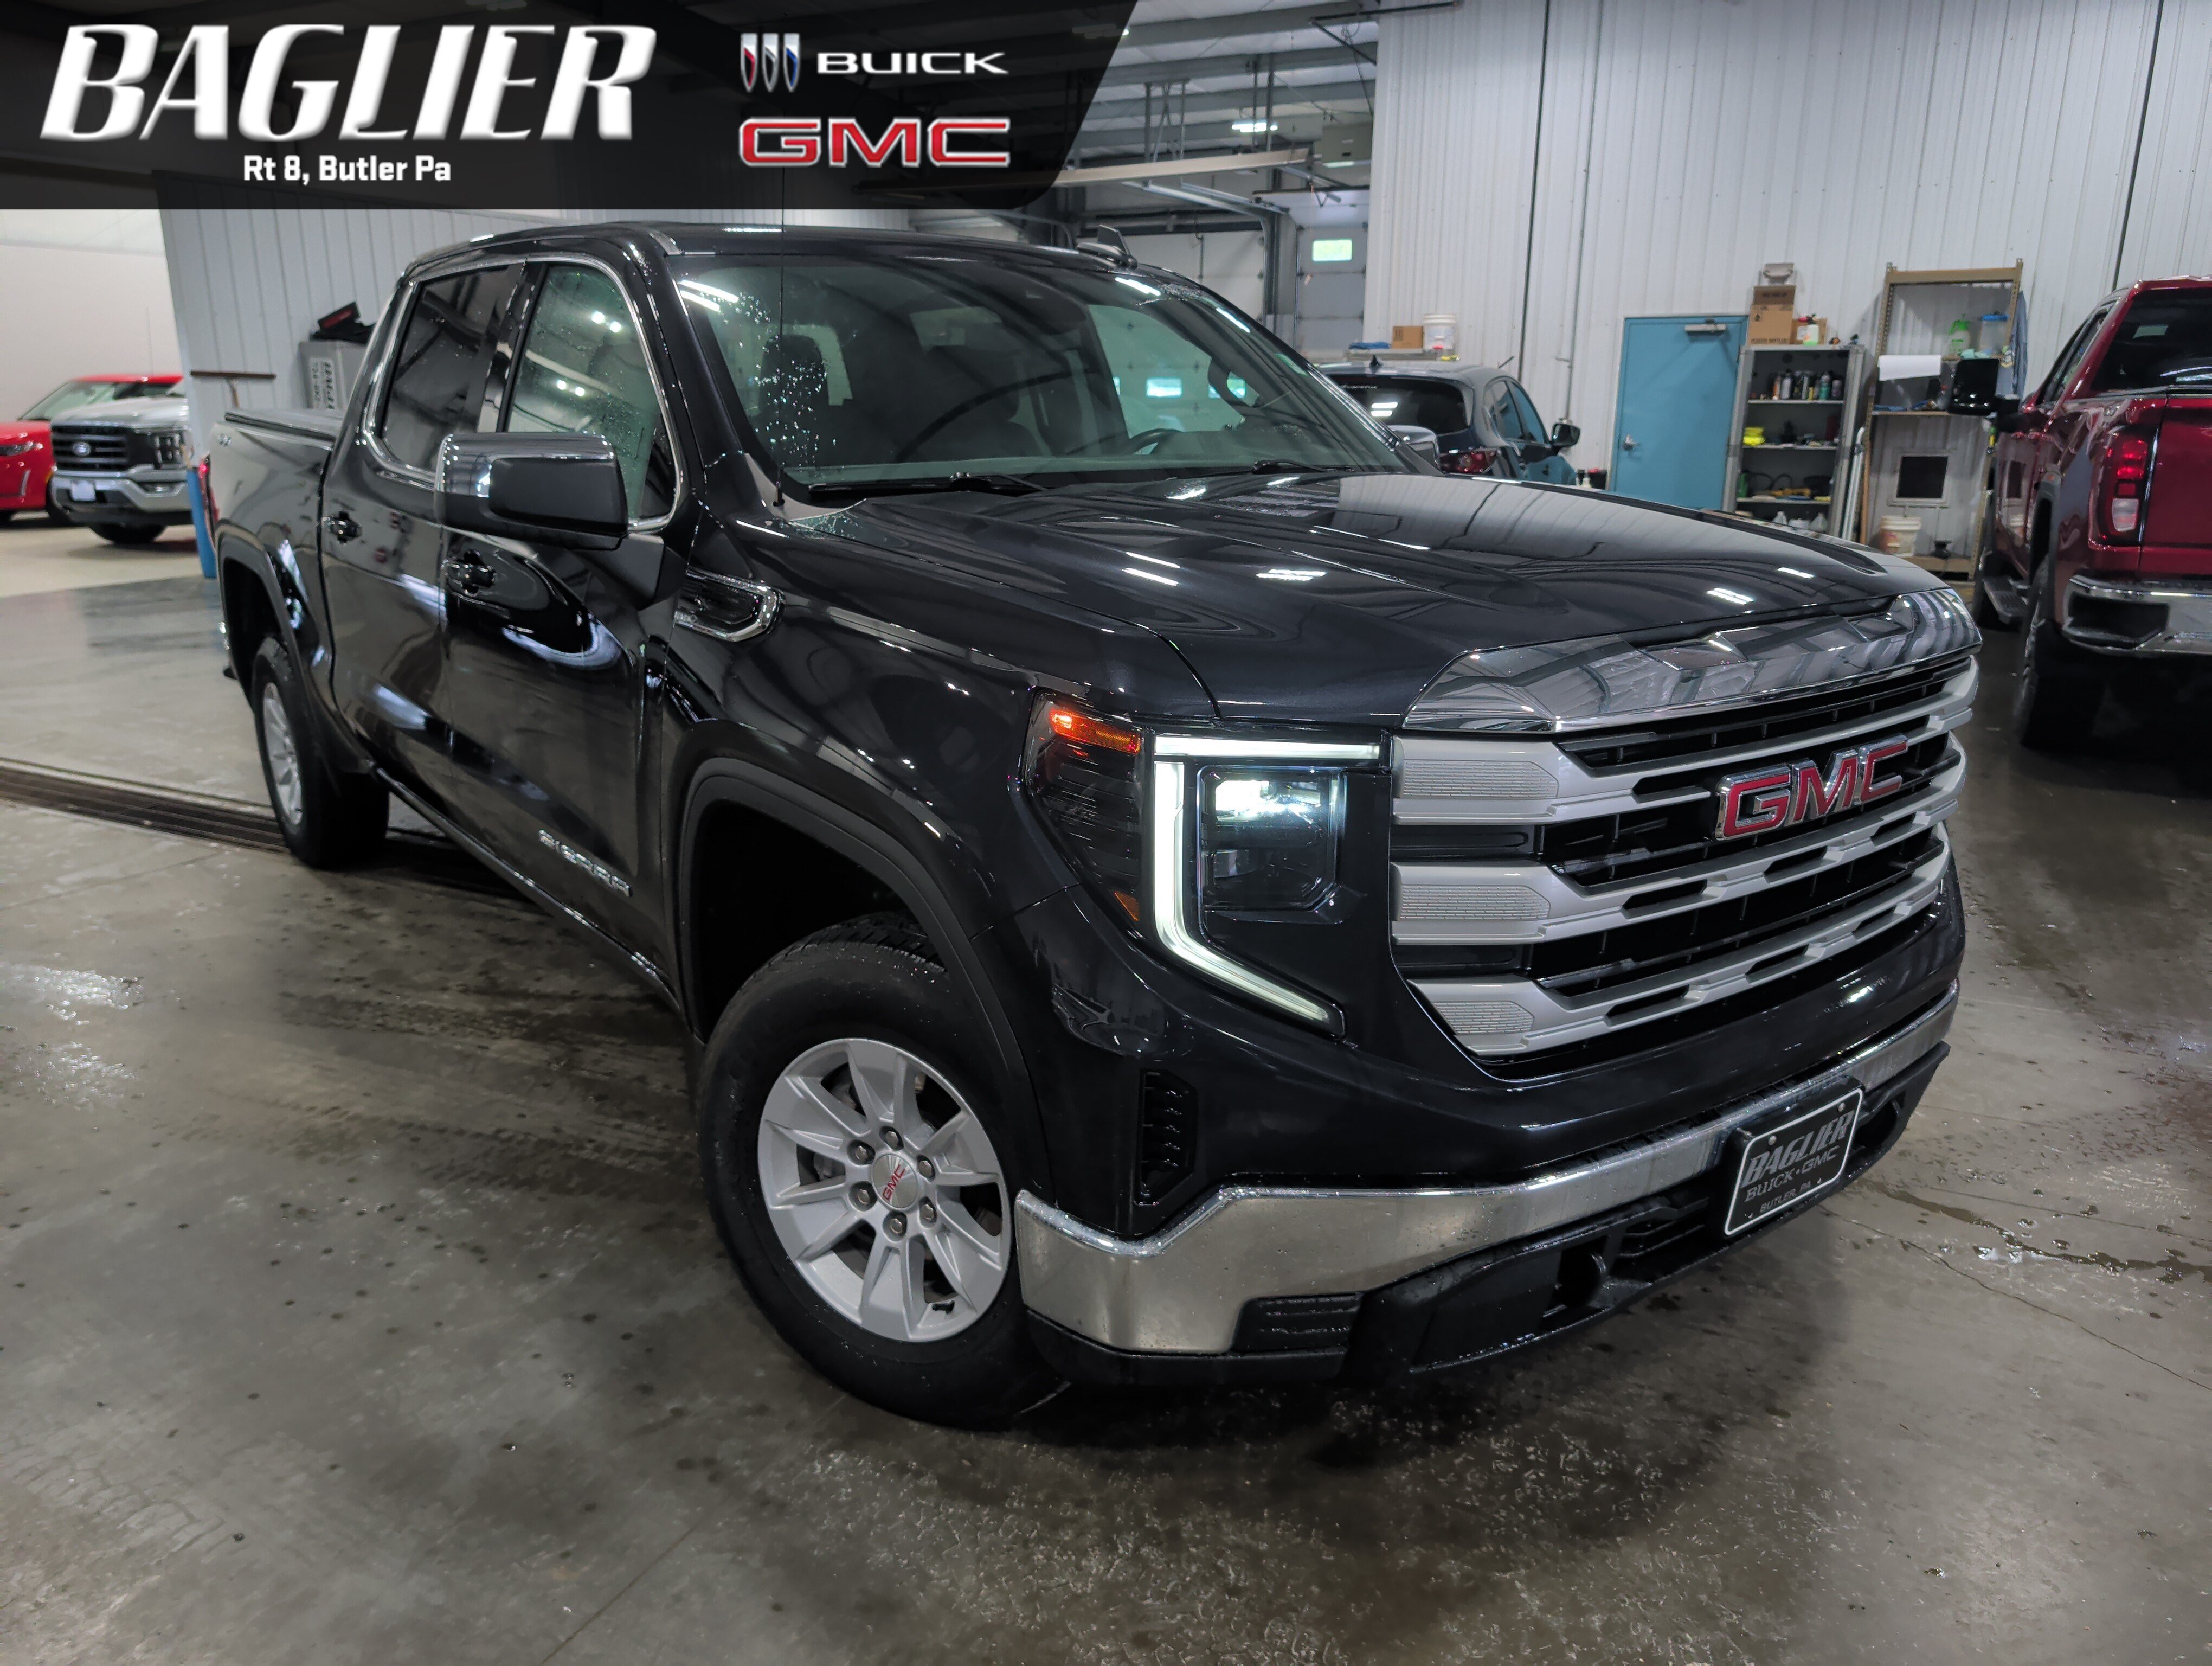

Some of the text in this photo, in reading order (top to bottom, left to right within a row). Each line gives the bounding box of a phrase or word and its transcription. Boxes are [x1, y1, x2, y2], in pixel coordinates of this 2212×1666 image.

[1715, 734, 1908, 841] GMC
[1740, 1110, 1855, 1188] BAGLIER
[1744, 1146, 1840, 1202] BUICK GMC
[882, 1164, 906, 1201] GMC
[1760, 1188, 1796, 1213] BUTLER
